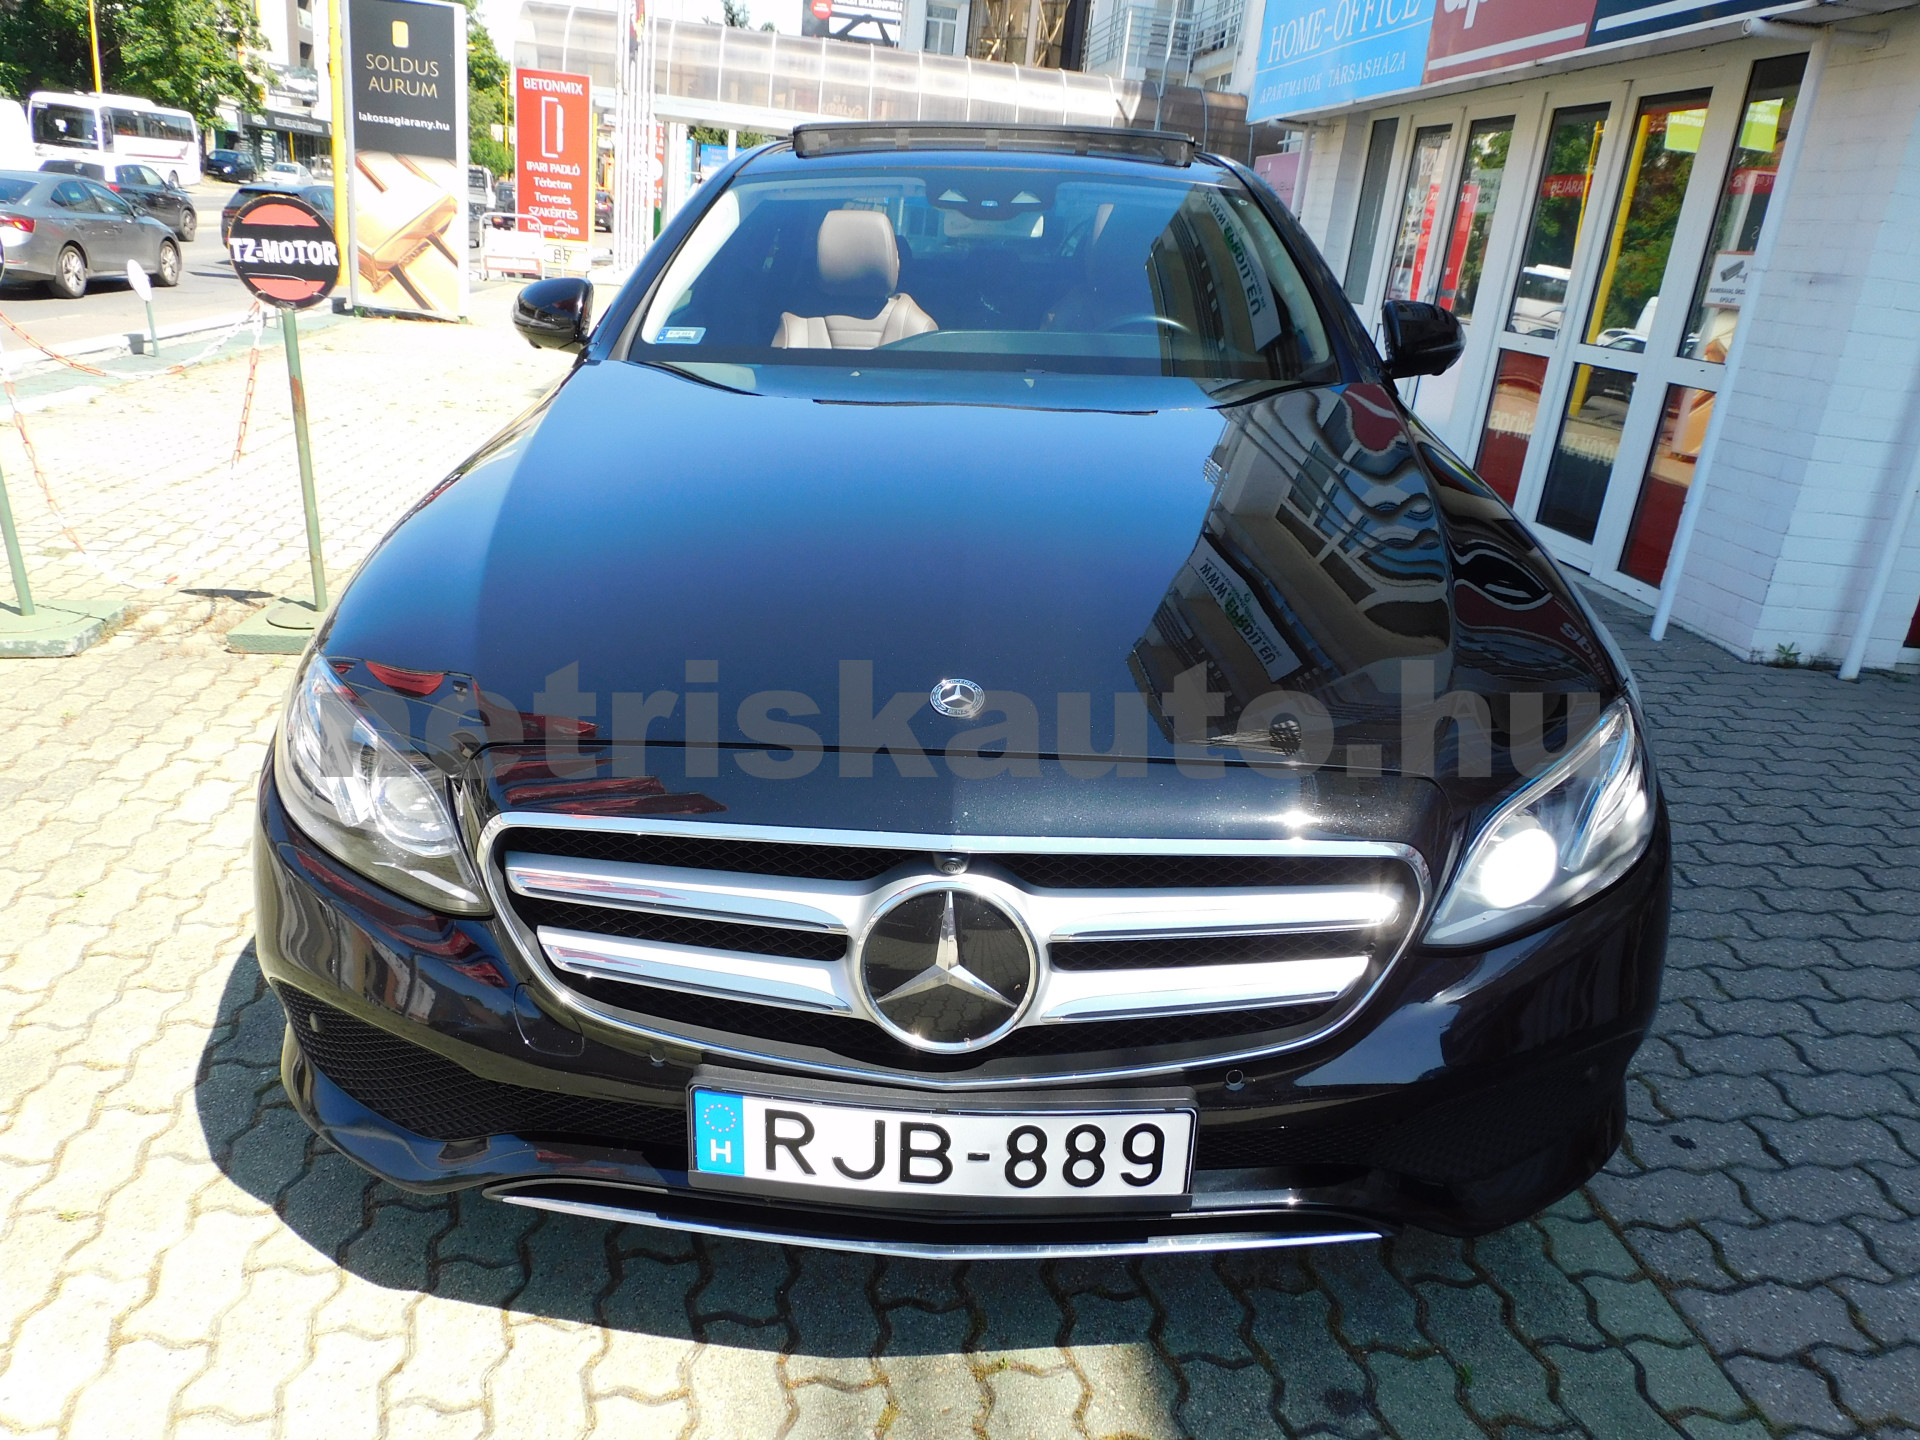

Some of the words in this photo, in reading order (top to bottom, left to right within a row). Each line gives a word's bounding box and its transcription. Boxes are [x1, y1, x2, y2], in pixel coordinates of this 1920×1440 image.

[366, 53, 440, 78] SOLDUS
[523, 77, 584, 96] BETONMIX
[1260, 74, 1322, 103] APARTMANOK
[1328, 51, 1406, 89] TÁRSASHÁZA
[368, 76, 438, 99] AURUM
[526, 161, 549, 173] IPARI
[550, 161, 581, 176] PADLÓ
[533, 176, 573, 190] Térbeton
[1550, 178, 1589, 194] BEJÁRA
[534, 191, 571, 205] Tervezés
[528, 205, 579, 220] SZAKÉRTÉS
[228, 237, 340, 267] TZ-MOTOR
[710, 1139, 732, 1164] H
[762, 1107, 1166, 1189] RJB-889
